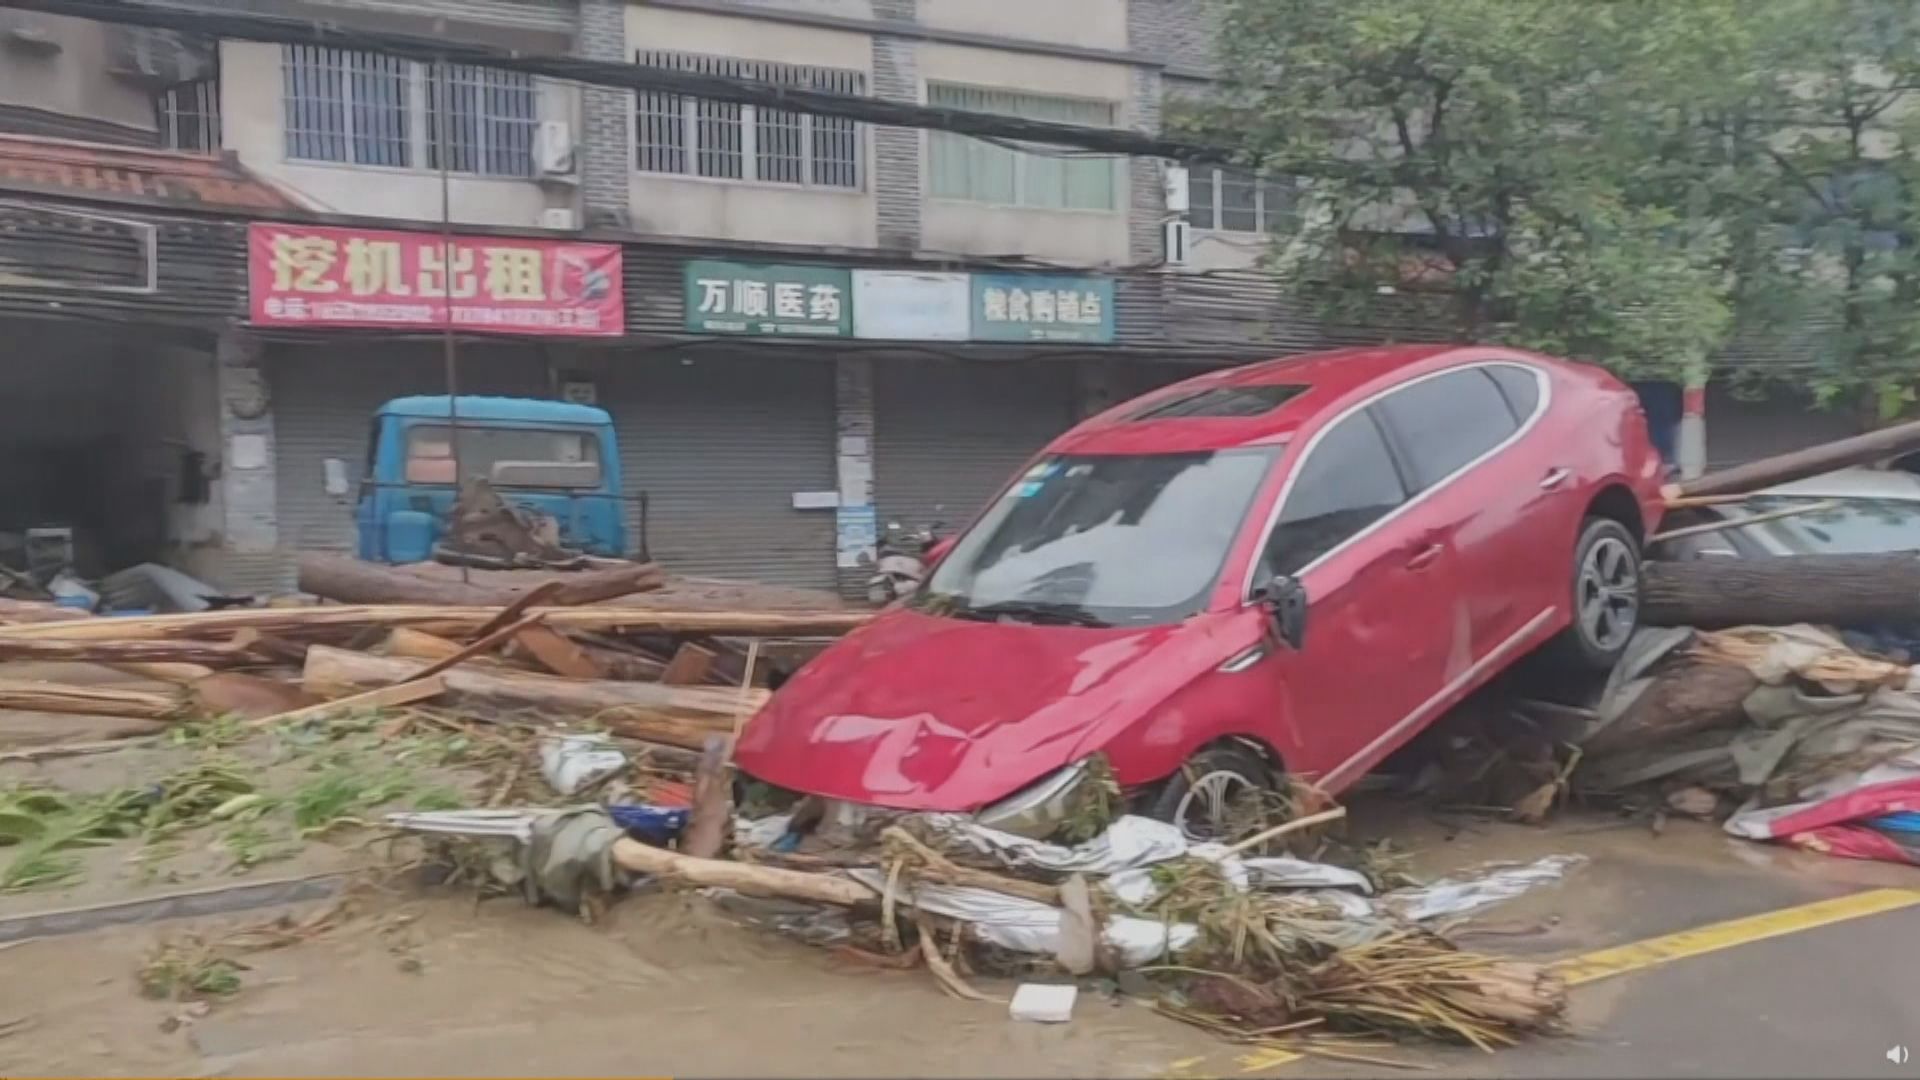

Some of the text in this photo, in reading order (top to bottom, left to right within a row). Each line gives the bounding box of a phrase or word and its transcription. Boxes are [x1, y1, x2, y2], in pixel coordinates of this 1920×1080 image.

[268, 233, 546, 301] 挖机出租
[697, 279, 841, 321] 万顺医药
